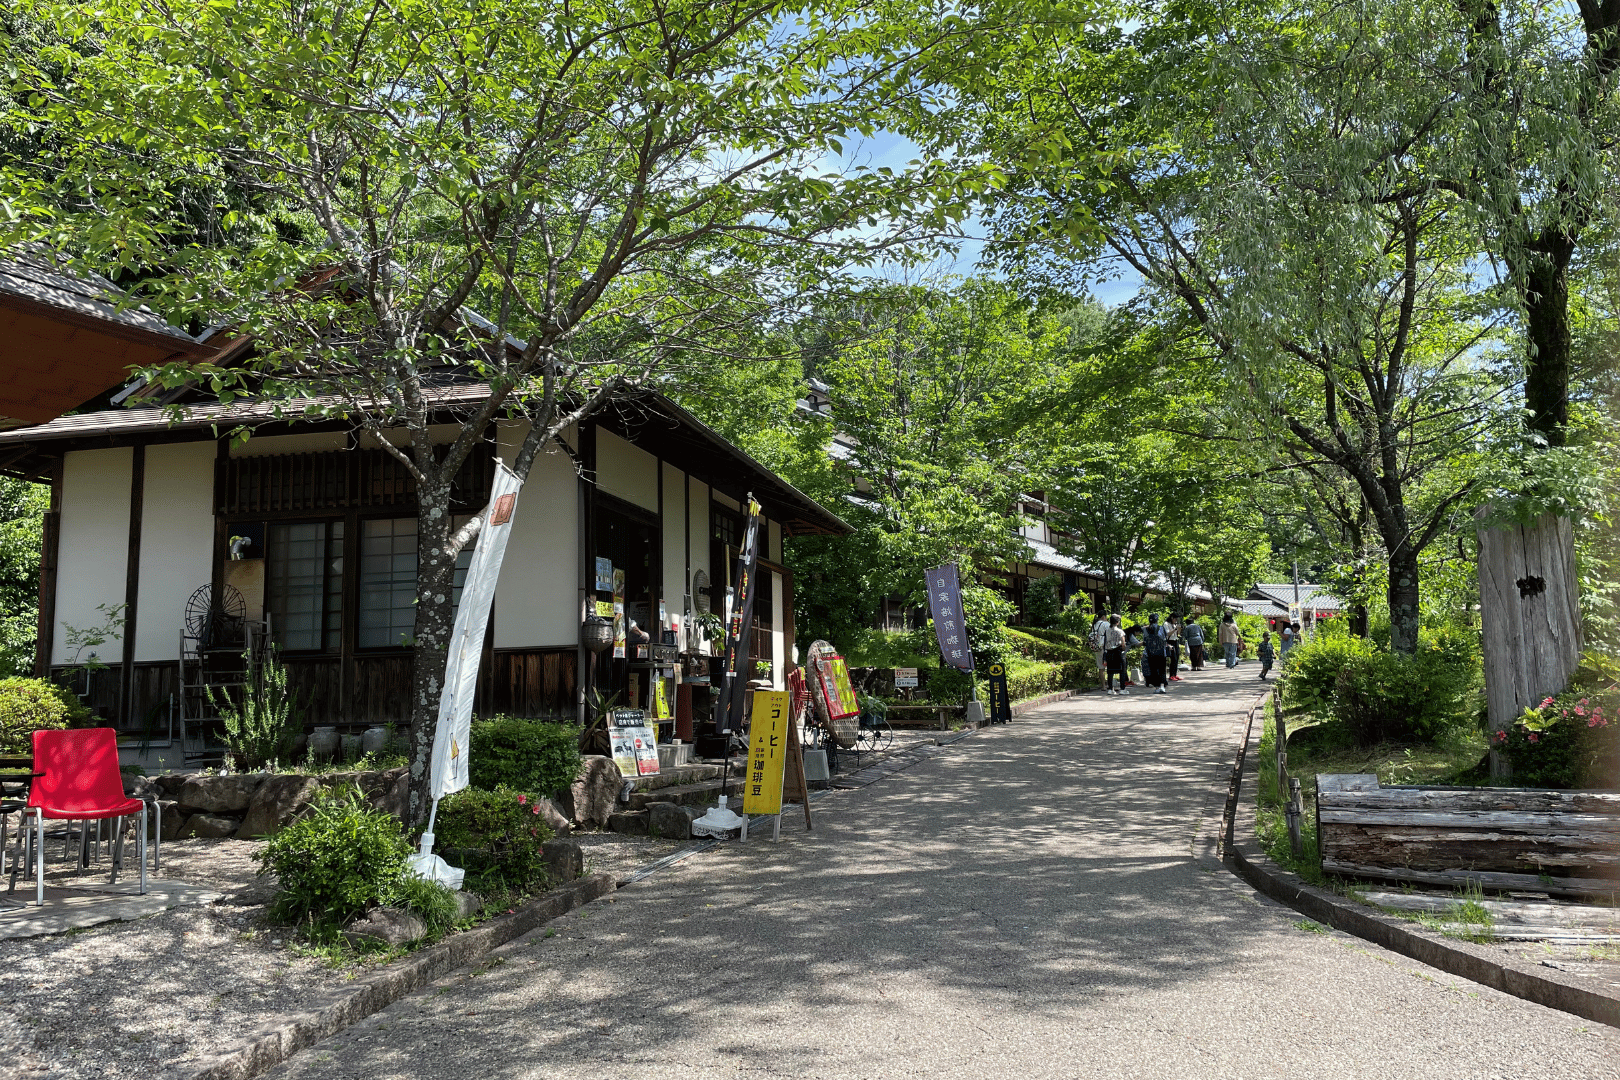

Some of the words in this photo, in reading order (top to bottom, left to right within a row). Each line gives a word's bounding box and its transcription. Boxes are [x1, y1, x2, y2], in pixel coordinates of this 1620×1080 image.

[770, 709, 780, 758] コーヒー
[751, 760, 764, 796] 珈琲豆
